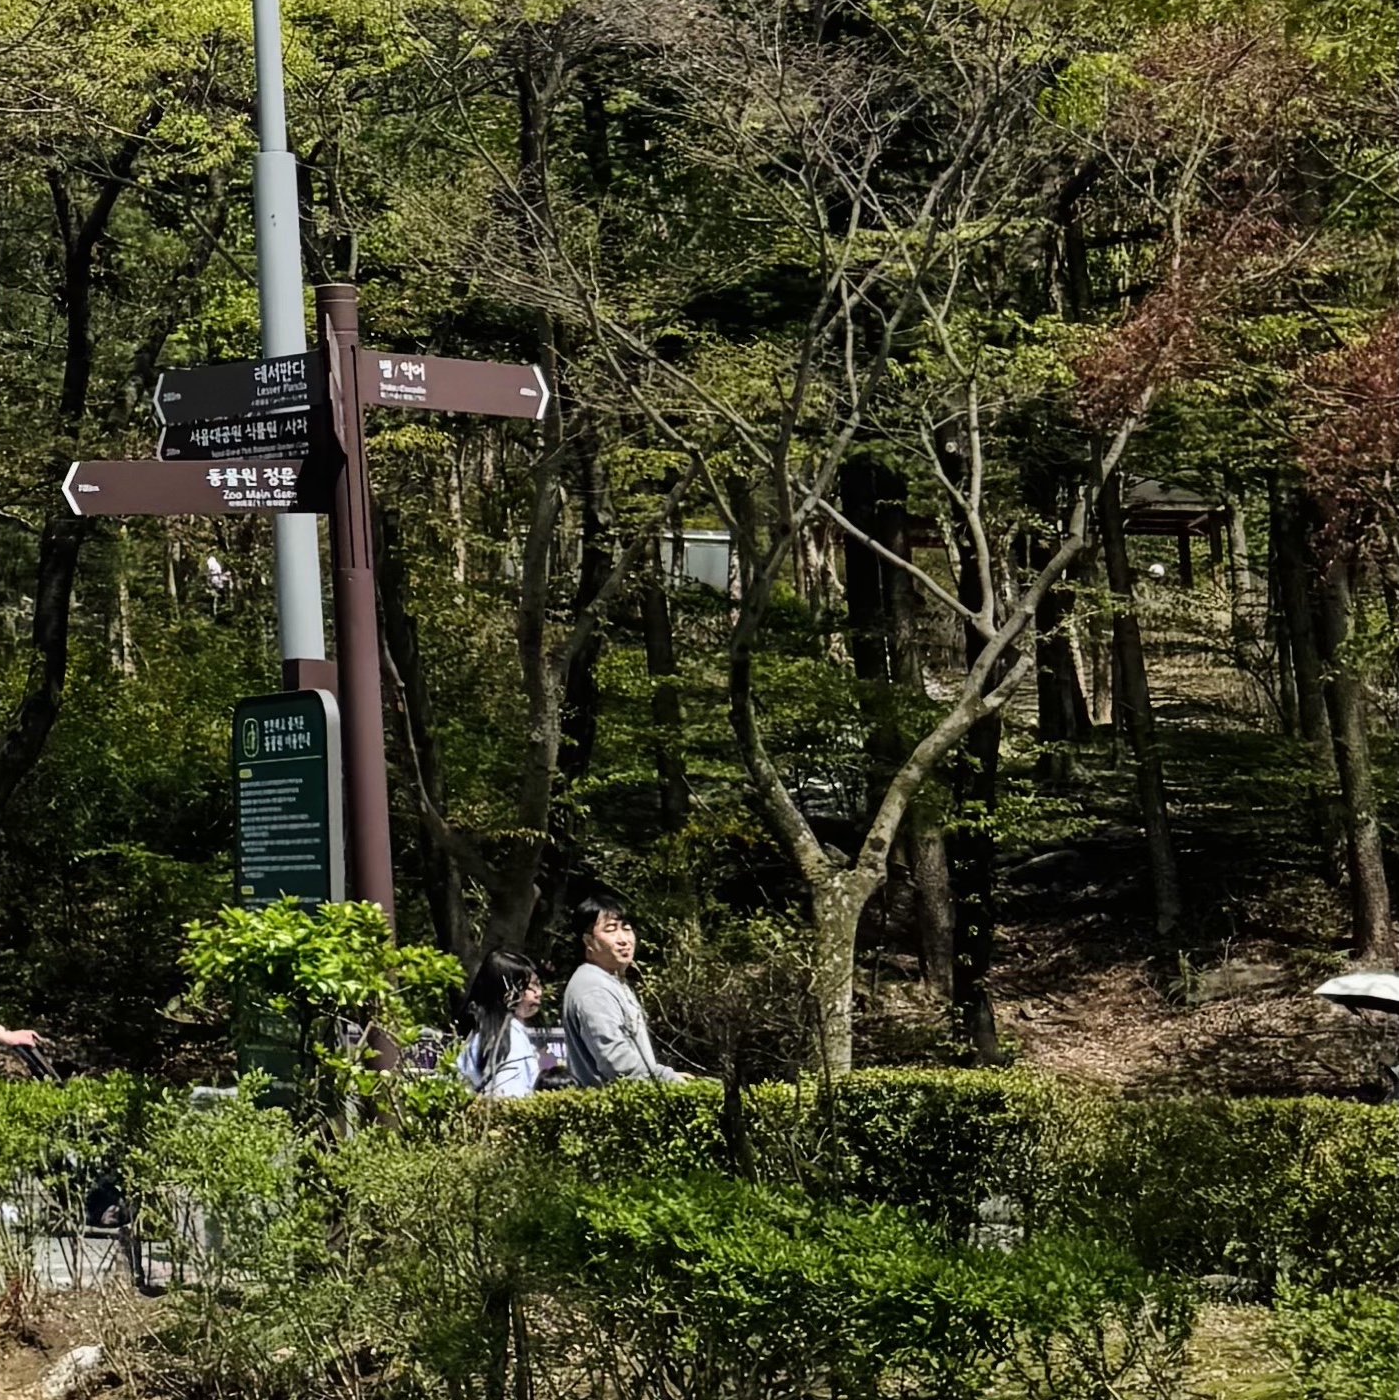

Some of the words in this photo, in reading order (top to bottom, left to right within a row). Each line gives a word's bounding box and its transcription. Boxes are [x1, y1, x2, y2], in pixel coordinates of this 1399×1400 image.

[190, 424, 243, 447] 서울대공원
[205, 467, 258, 487] 동물원
[263, 467, 298, 487] 정문
[222, 489, 243, 500] Zoo
[246, 488, 271, 499] Main
